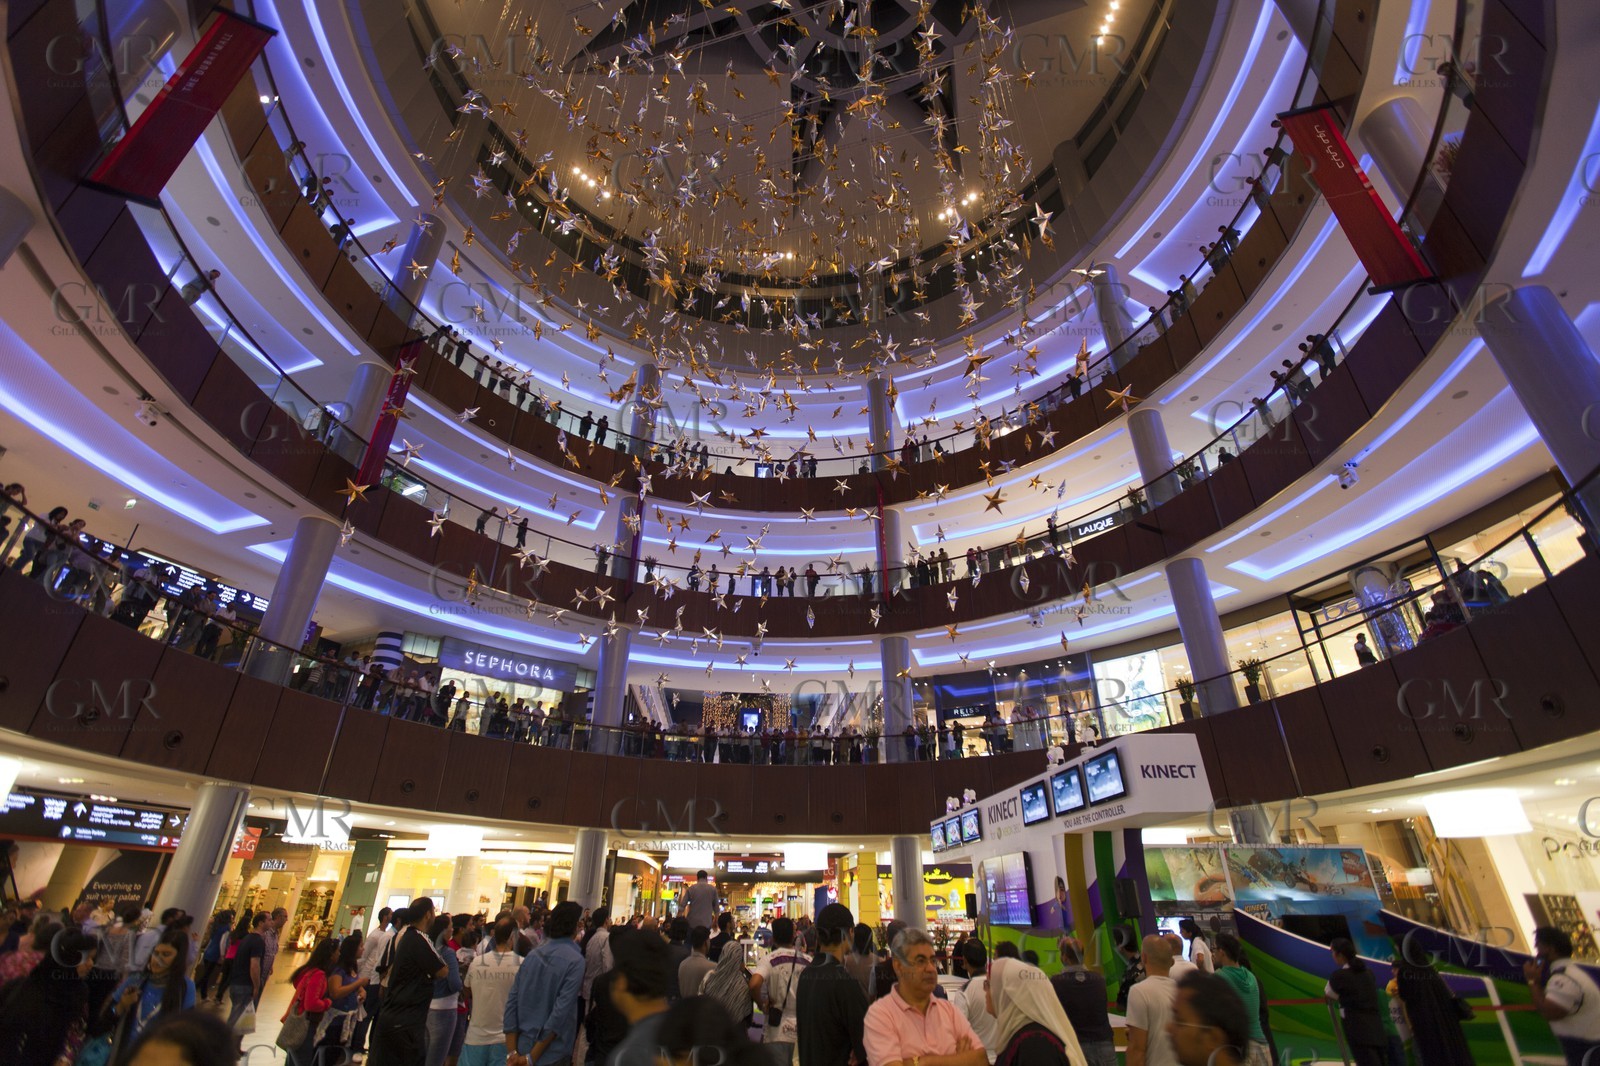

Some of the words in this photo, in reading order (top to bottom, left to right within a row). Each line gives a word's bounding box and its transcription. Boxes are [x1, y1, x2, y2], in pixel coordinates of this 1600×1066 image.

[1078, 517, 1114, 536] LALIQUE
[464, 650, 554, 681] SEPHORA
[953, 706, 980, 716] REISS
[1140, 764, 1197, 779] KINECT
[988, 796, 1018, 825] KINECT
[1063, 819, 1072, 829] YOU
[1073, 816, 1082, 827] ARE
[1082, 813, 1092, 824] THE
[92, 882, 133, 892] Everything
[118, 894, 141, 903] palate
[1244, 903, 1268, 912] KINECT
